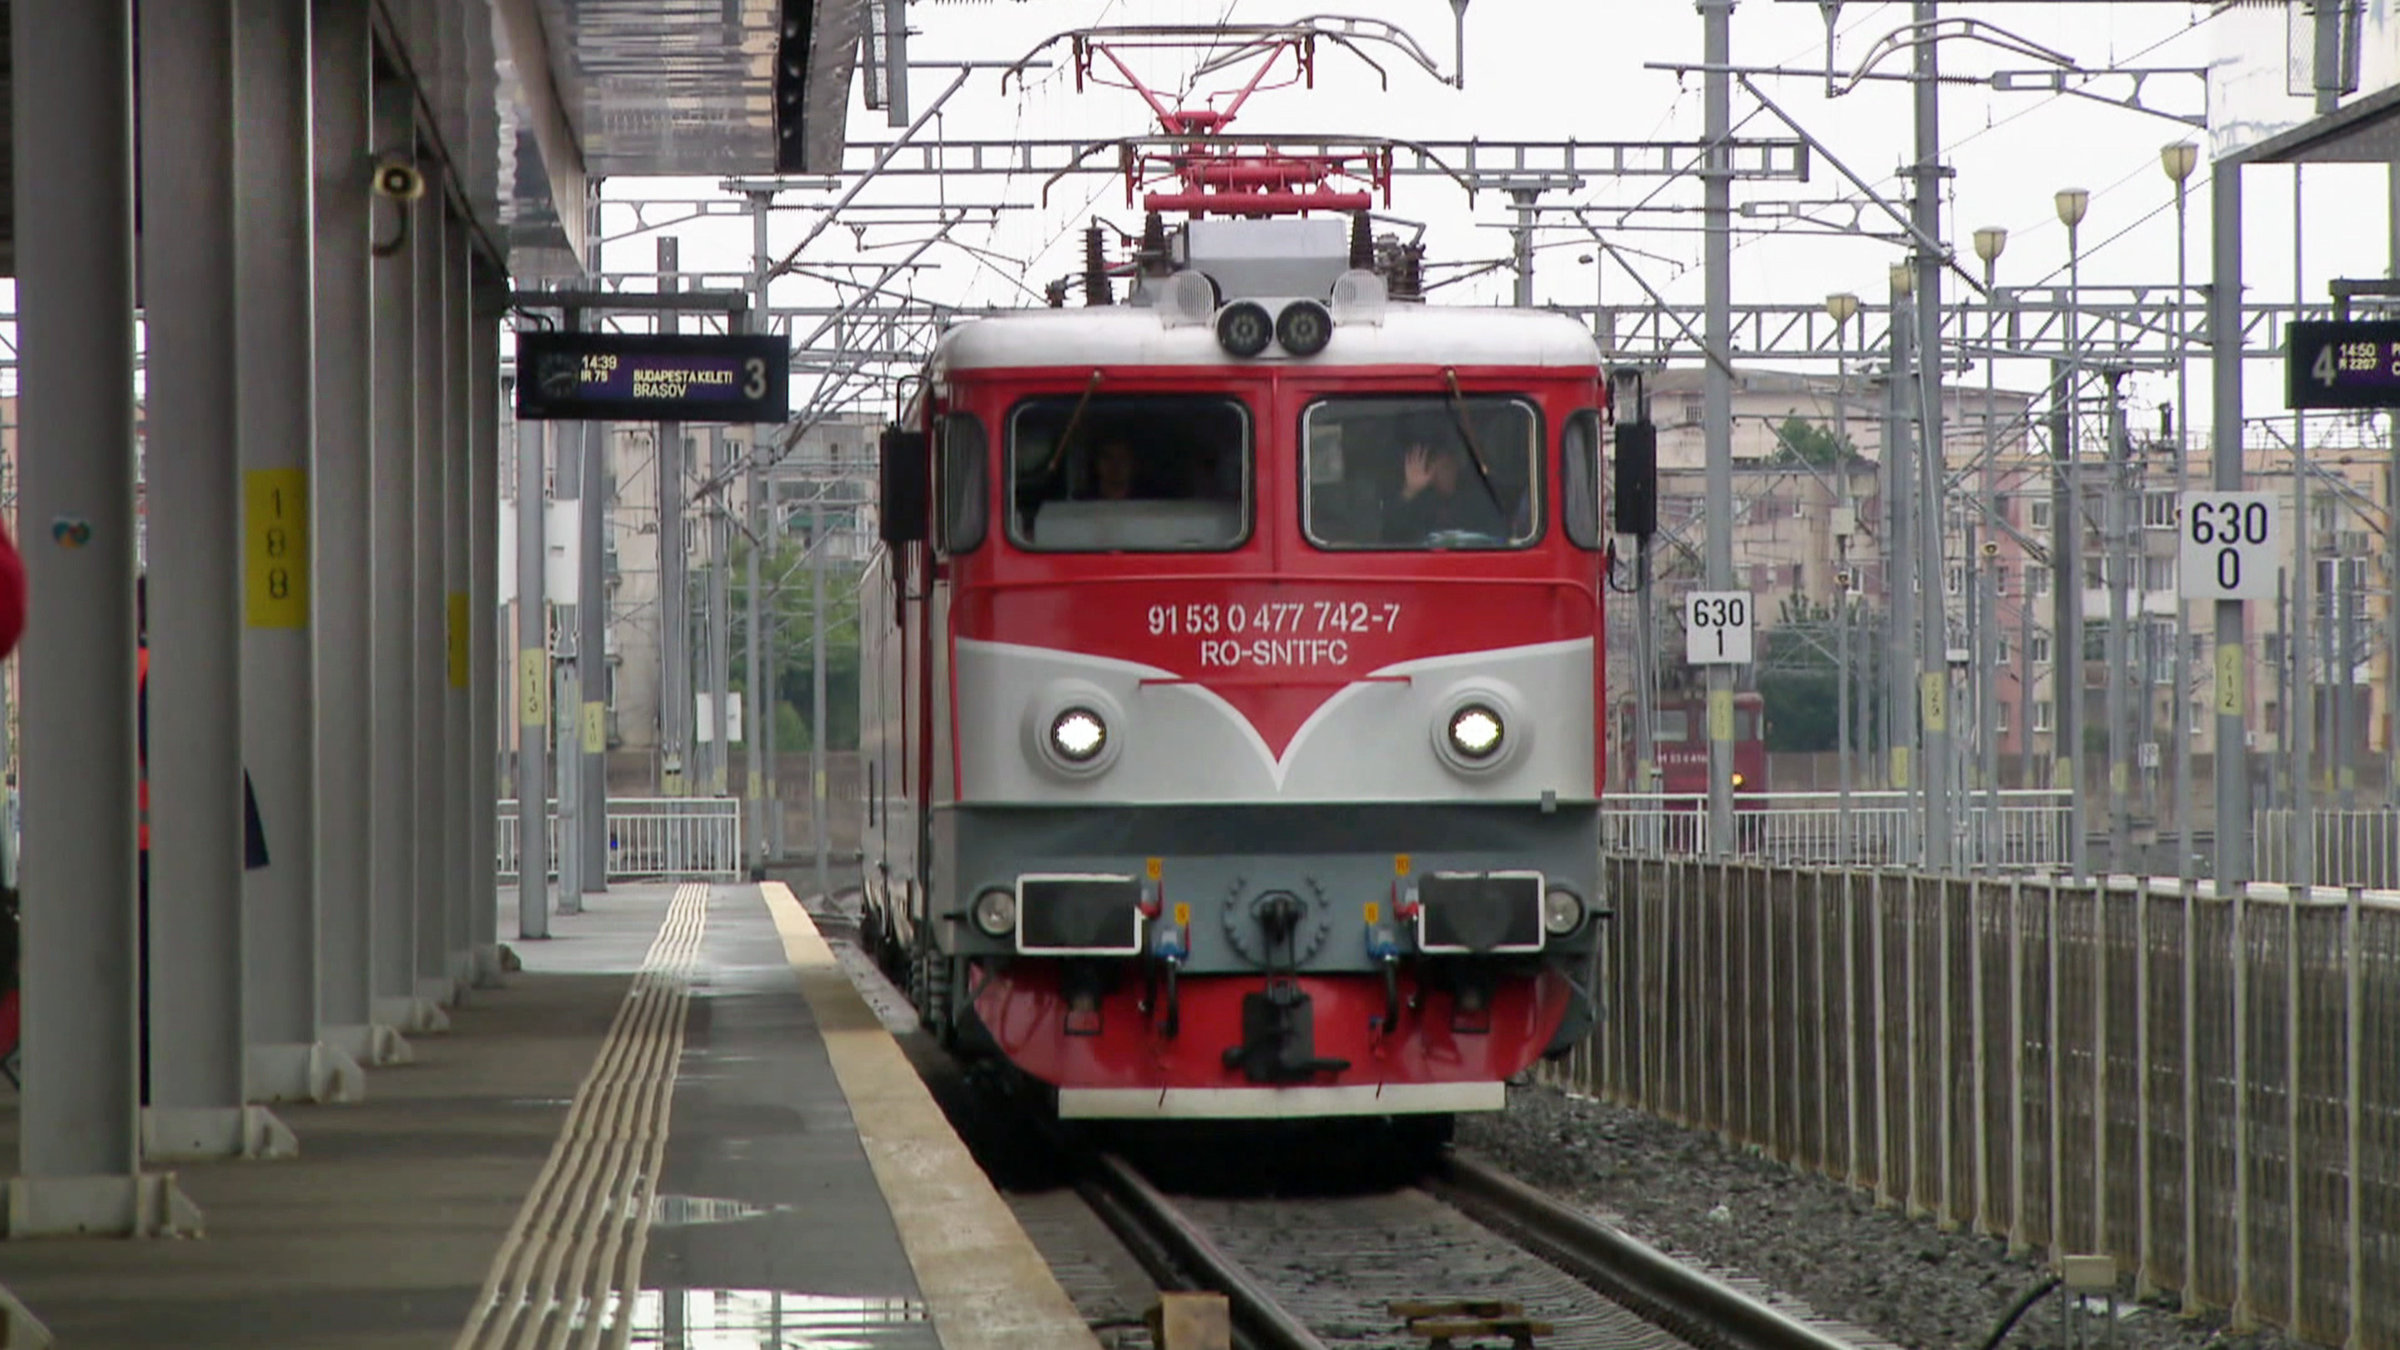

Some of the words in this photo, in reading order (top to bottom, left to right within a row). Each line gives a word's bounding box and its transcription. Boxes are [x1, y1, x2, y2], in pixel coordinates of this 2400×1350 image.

[582, 355, 617, 370] 14:39
[2312, 345, 2336, 387] 4
[581, 371, 592, 383] IR
[698, 371, 733, 384] KELETI
[744, 358, 767, 399] 3
[2191, 502, 2268, 544] 630
[2217, 547, 2240, 590] 0
[1148, 605, 1178, 635] 91
[1186, 604, 1220, 634] 53
[1227, 604, 1246, 633] 0
[1253, 603, 1304, 633] 477
[1314, 601, 1401, 633] 742-7
[1694, 599, 1744, 627] 630
[1201, 639, 1348, 667] RO-SNTFC
[1716, 628, 1724, 656] 1
